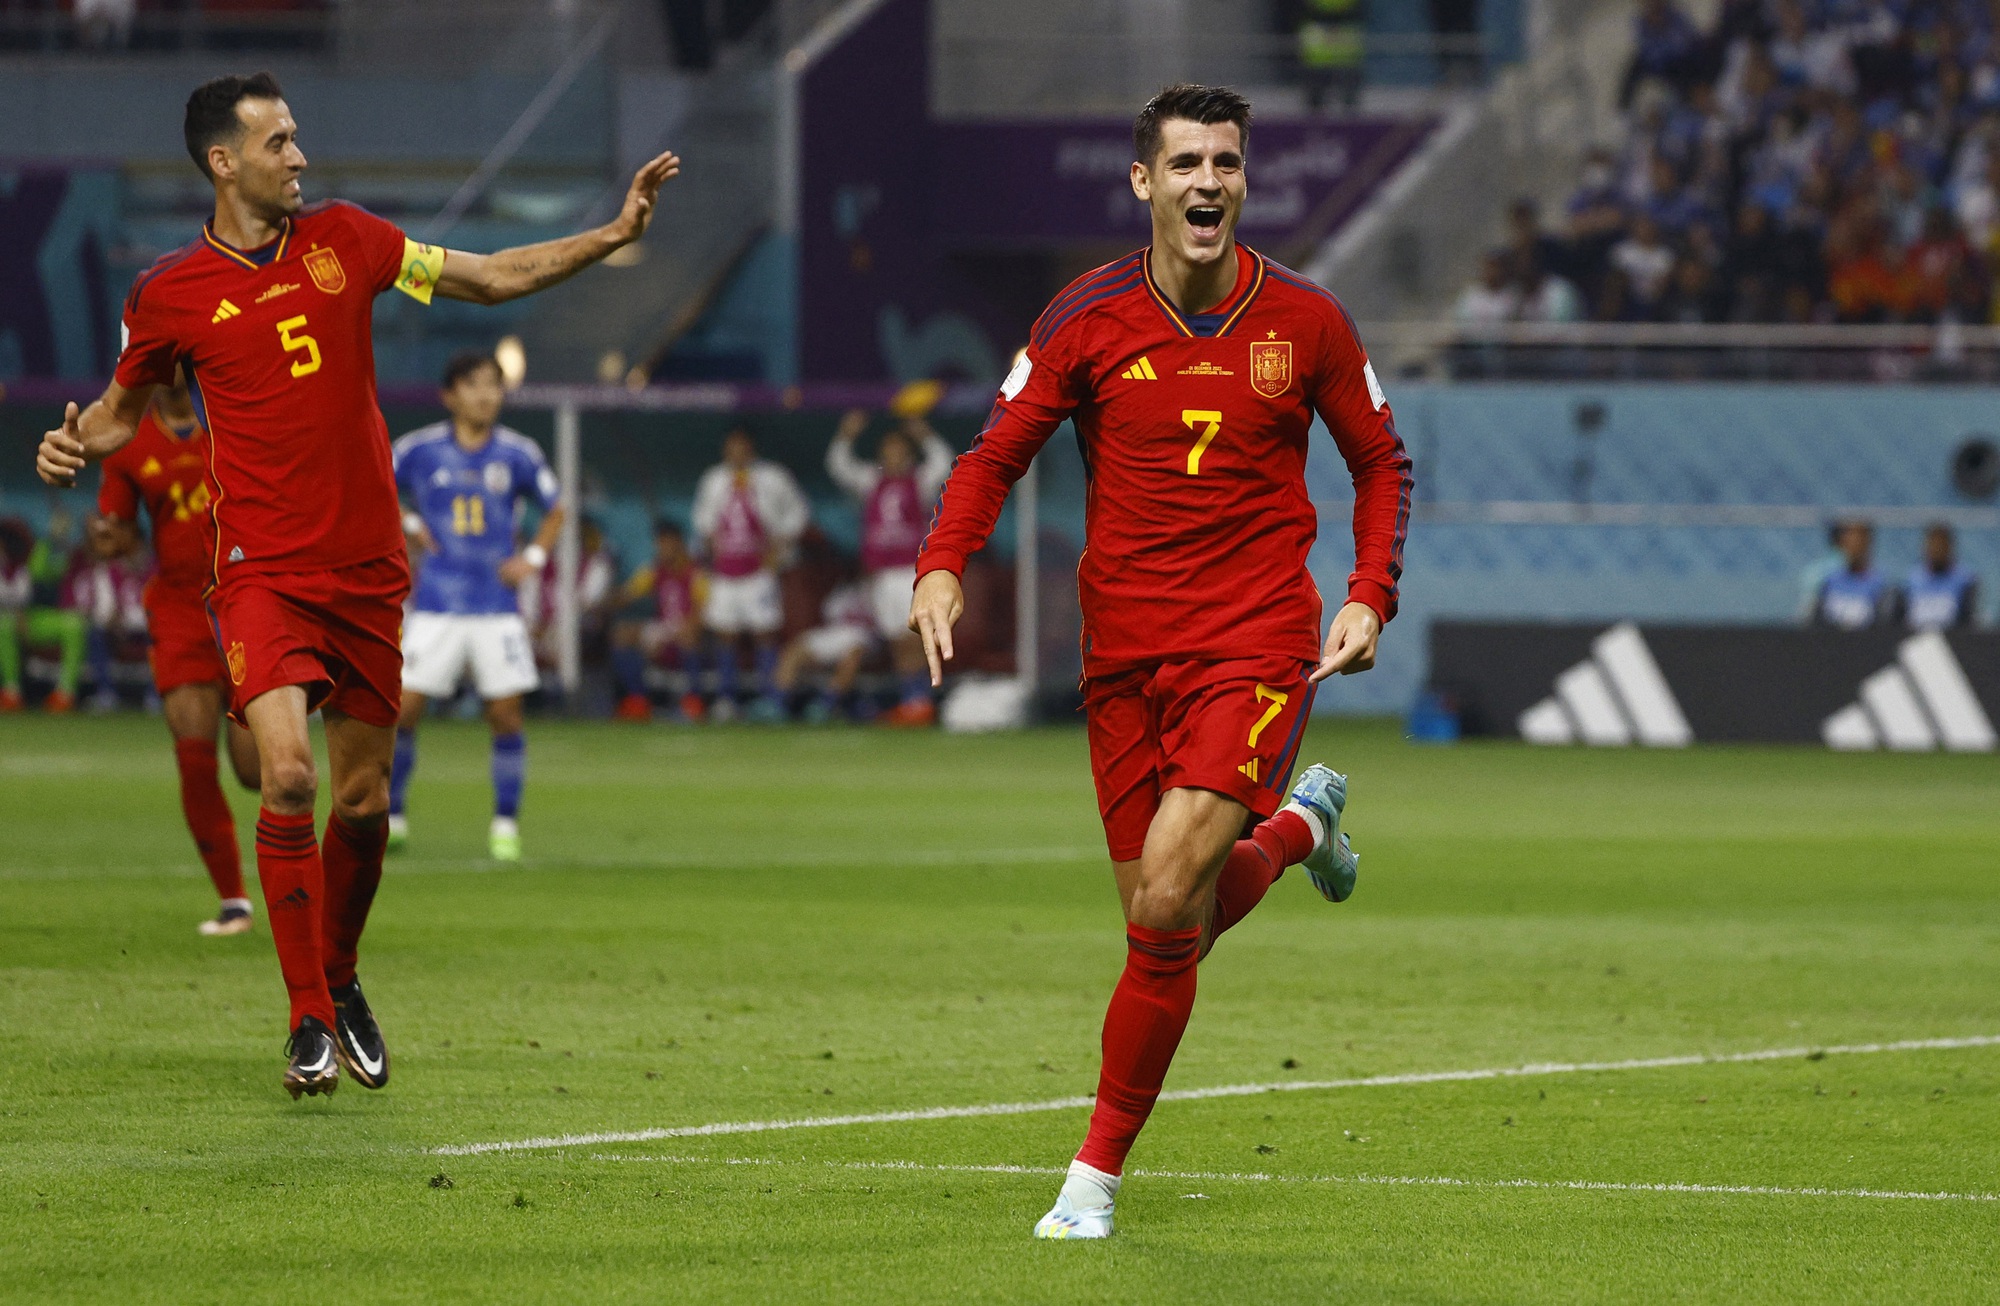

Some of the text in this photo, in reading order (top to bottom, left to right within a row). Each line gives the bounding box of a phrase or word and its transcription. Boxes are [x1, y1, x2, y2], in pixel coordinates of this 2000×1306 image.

[276, 314, 322, 378] 5
[1182, 409, 1222, 475] 7
[451, 494, 487, 537] 11
[1248, 683, 1288, 749] 7
